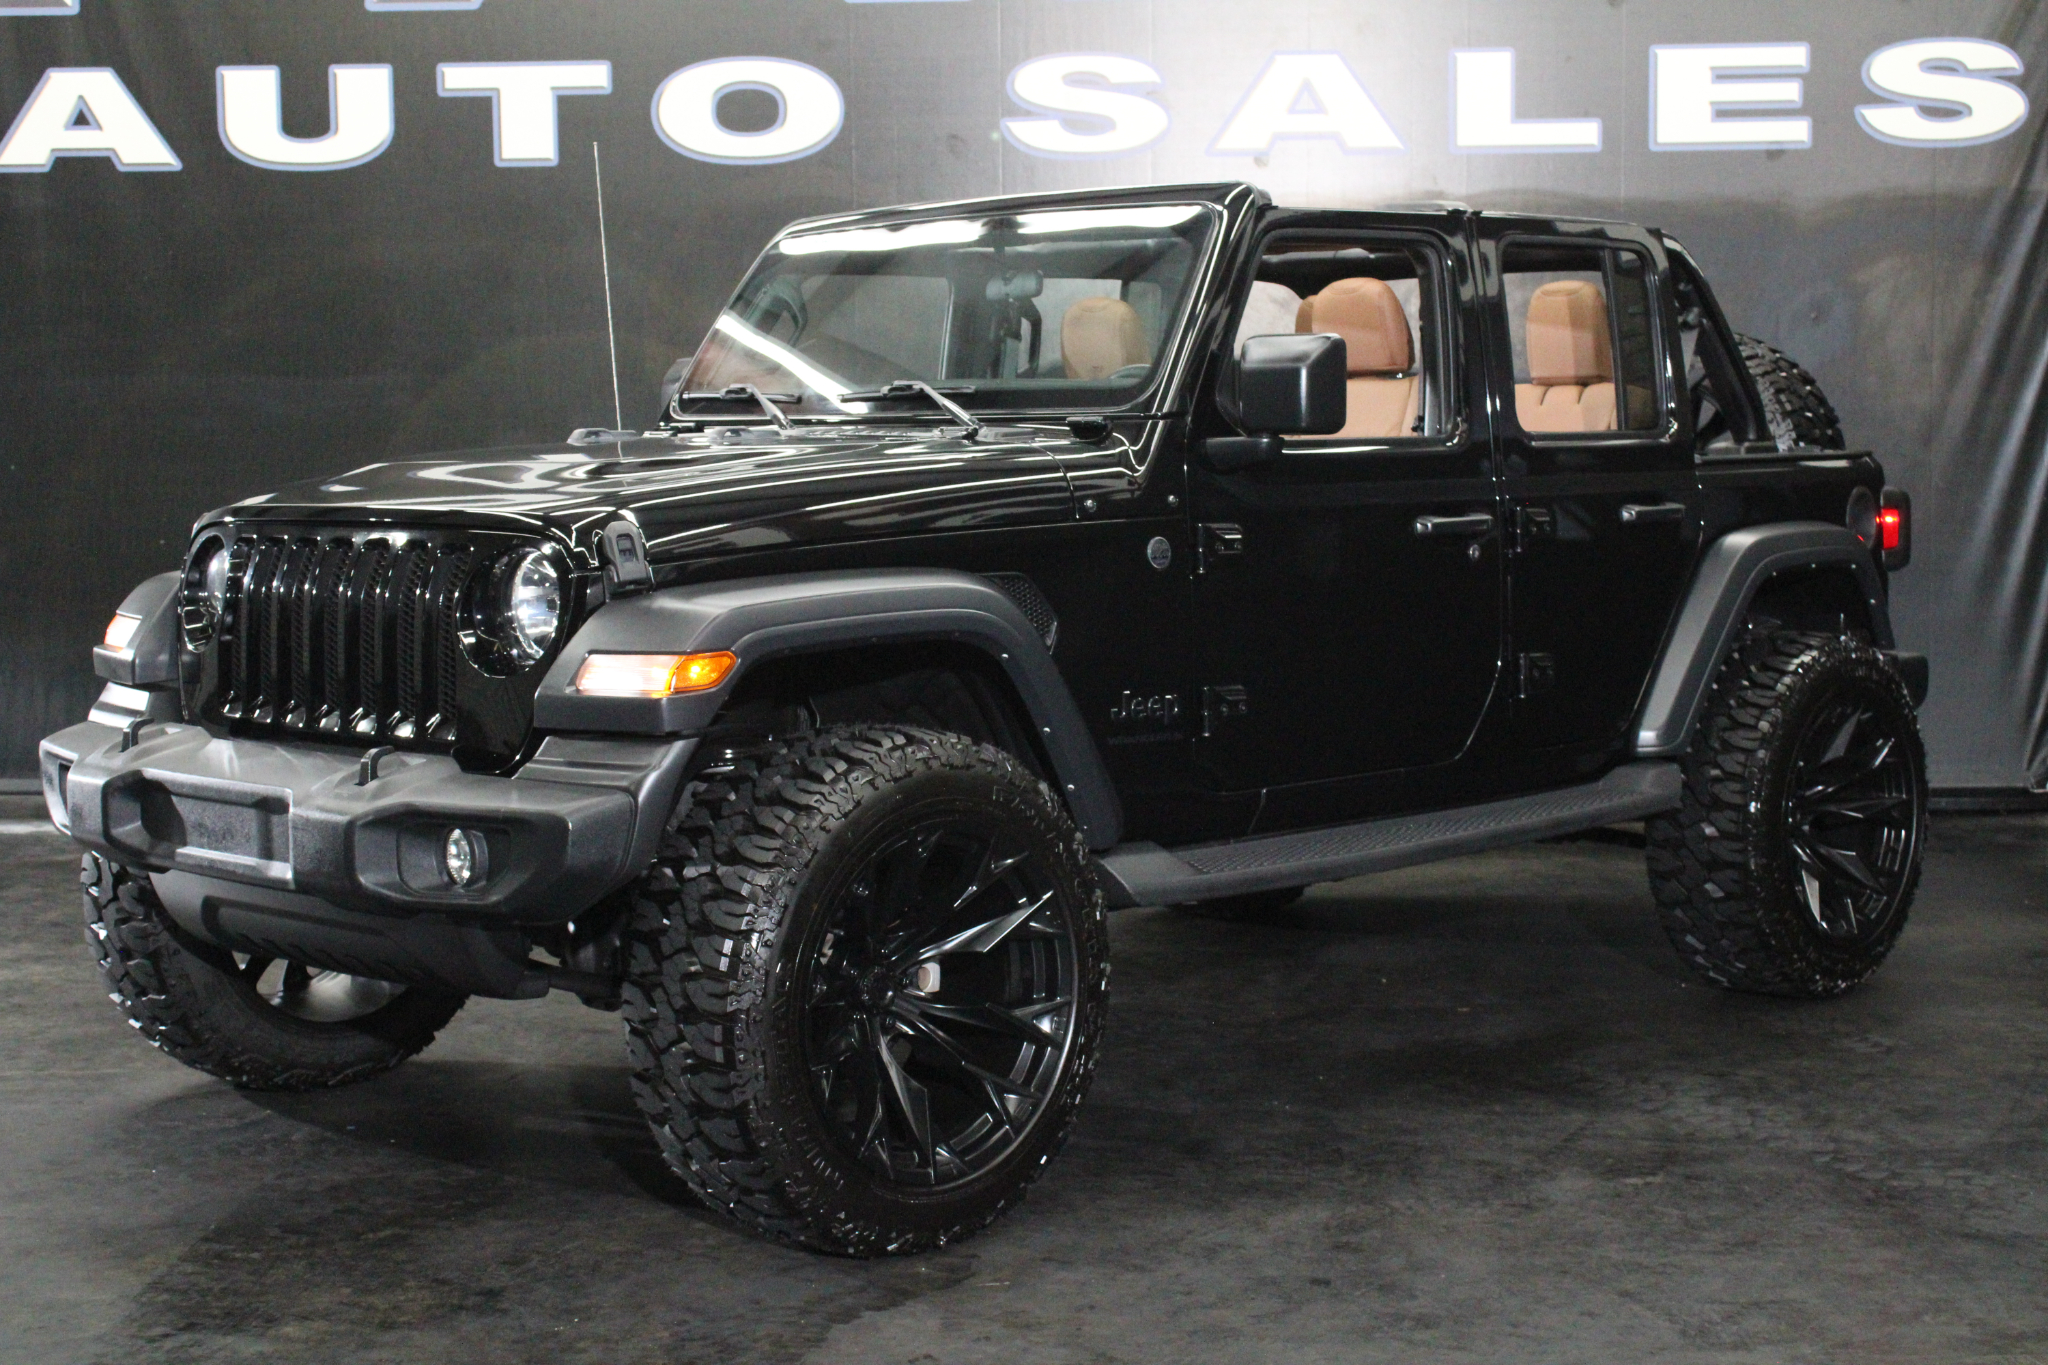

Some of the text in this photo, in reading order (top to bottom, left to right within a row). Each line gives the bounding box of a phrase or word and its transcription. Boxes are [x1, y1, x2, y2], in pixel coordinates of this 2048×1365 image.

[0, 37, 2030, 171] AUTO SALES
[1110, 689, 1179, 726] Jeep
